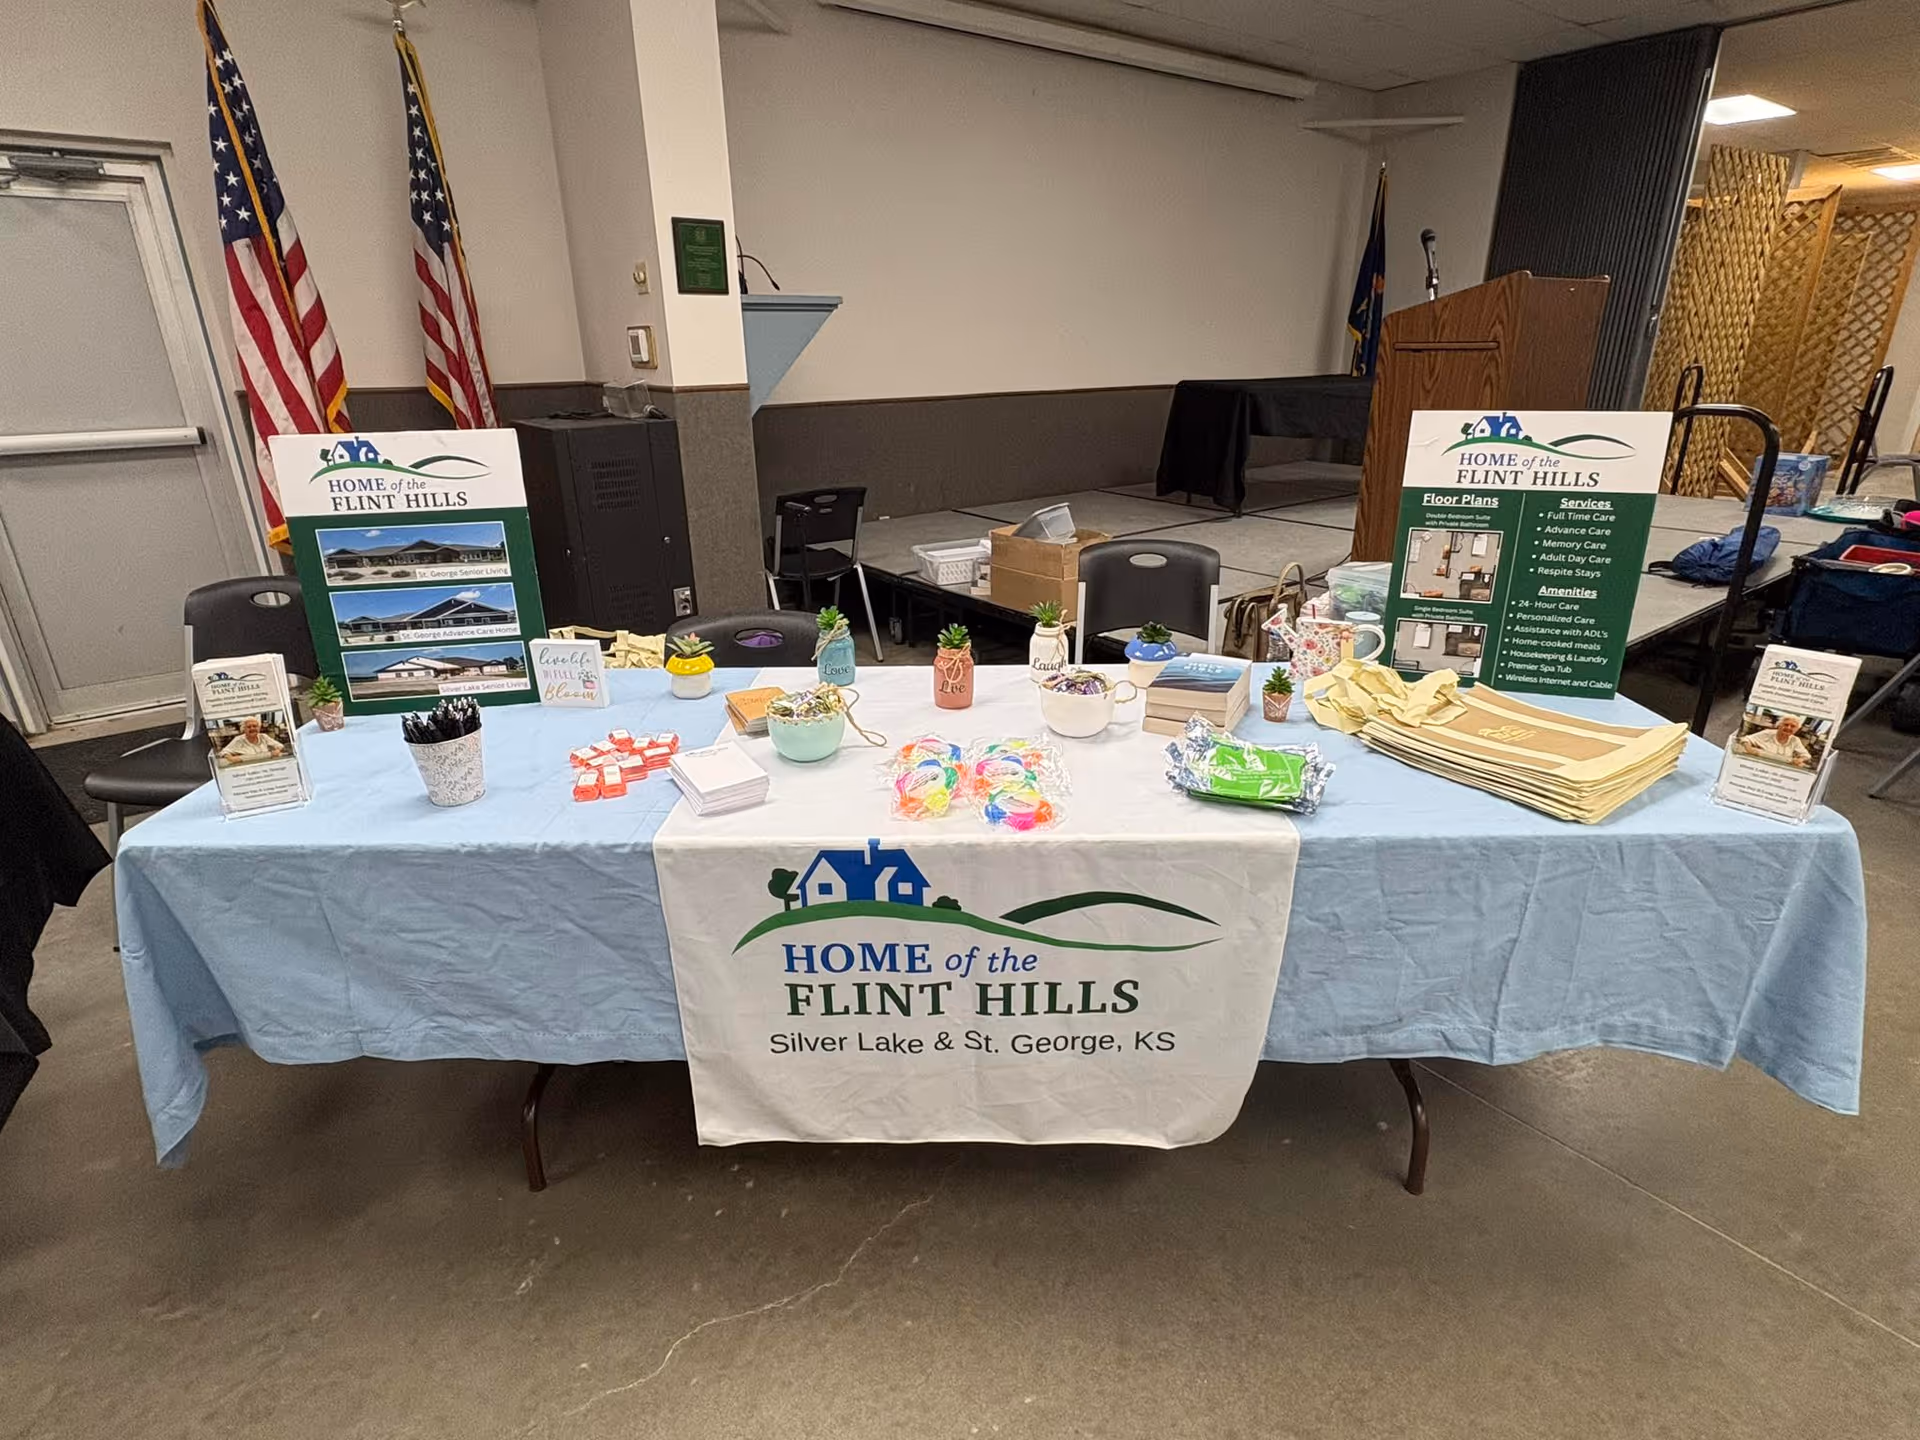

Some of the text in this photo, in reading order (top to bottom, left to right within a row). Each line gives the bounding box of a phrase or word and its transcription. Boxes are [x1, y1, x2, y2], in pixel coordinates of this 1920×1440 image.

[1459, 452, 1560, 470] HOME of the
[1456, 469, 1600, 487] FLINT HILLS
[328, 478, 427, 493] HOME of the
[331, 491, 468, 511] FLINT HILLS
[1423, 493, 1499, 507] Floor Plans
[1560, 497, 1611, 508] Services
[1547, 511, 1616, 522] Full Time Care
[1544, 525, 1611, 536] Advance Care
[1542, 540, 1607, 550] Memory Care
[1539, 553, 1612, 564] Adult Day Care
[430, 569, 458, 578] George
[460, 569, 484, 577] Senior
[486, 567, 508, 576] Living
[1537, 567, 1601, 578] Respite Stays
[1538, 585, 1598, 597] Amenities
[1535, 601, 1555, 609] Hour
[1558, 602, 1580, 610] Care
[1516, 613, 1595, 625] Personalized Care
[414, 631, 441, 640] George
[443, 629, 475, 637] Advance
[495, 626, 518, 634] Home
[1513, 625, 1608, 638] Assistance with ADL's
[1512, 637, 1601, 651] Home-cooked meals
[539, 647, 592, 668] live life
[1031, 656, 1067, 672] Laugh
[1510, 650, 1566, 662] Housekeeping
[1573, 655, 1608, 665] Laundry
[823, 662, 850, 676] Love
[1507, 662, 1572, 674] Premier Spa Tub
[1772, 671, 1794, 679] HOME
[441, 680, 528, 693] Silver Lake Senior Living
[939, 680, 966, 694] Lve
[1505, 674, 1613, 689] Wireless Internet and Cable
[1770, 676, 1825, 691] FLINT HILLS
[212, 684, 261, 695] FLINT HILLS
[544, 681, 598, 701] Bloom
[782, 943, 1038, 978] HOME of the
[784, 979, 1139, 1017] FLINT HILLS
[770, 1030, 1176, 1055] Silver Lake & St. George, KS
